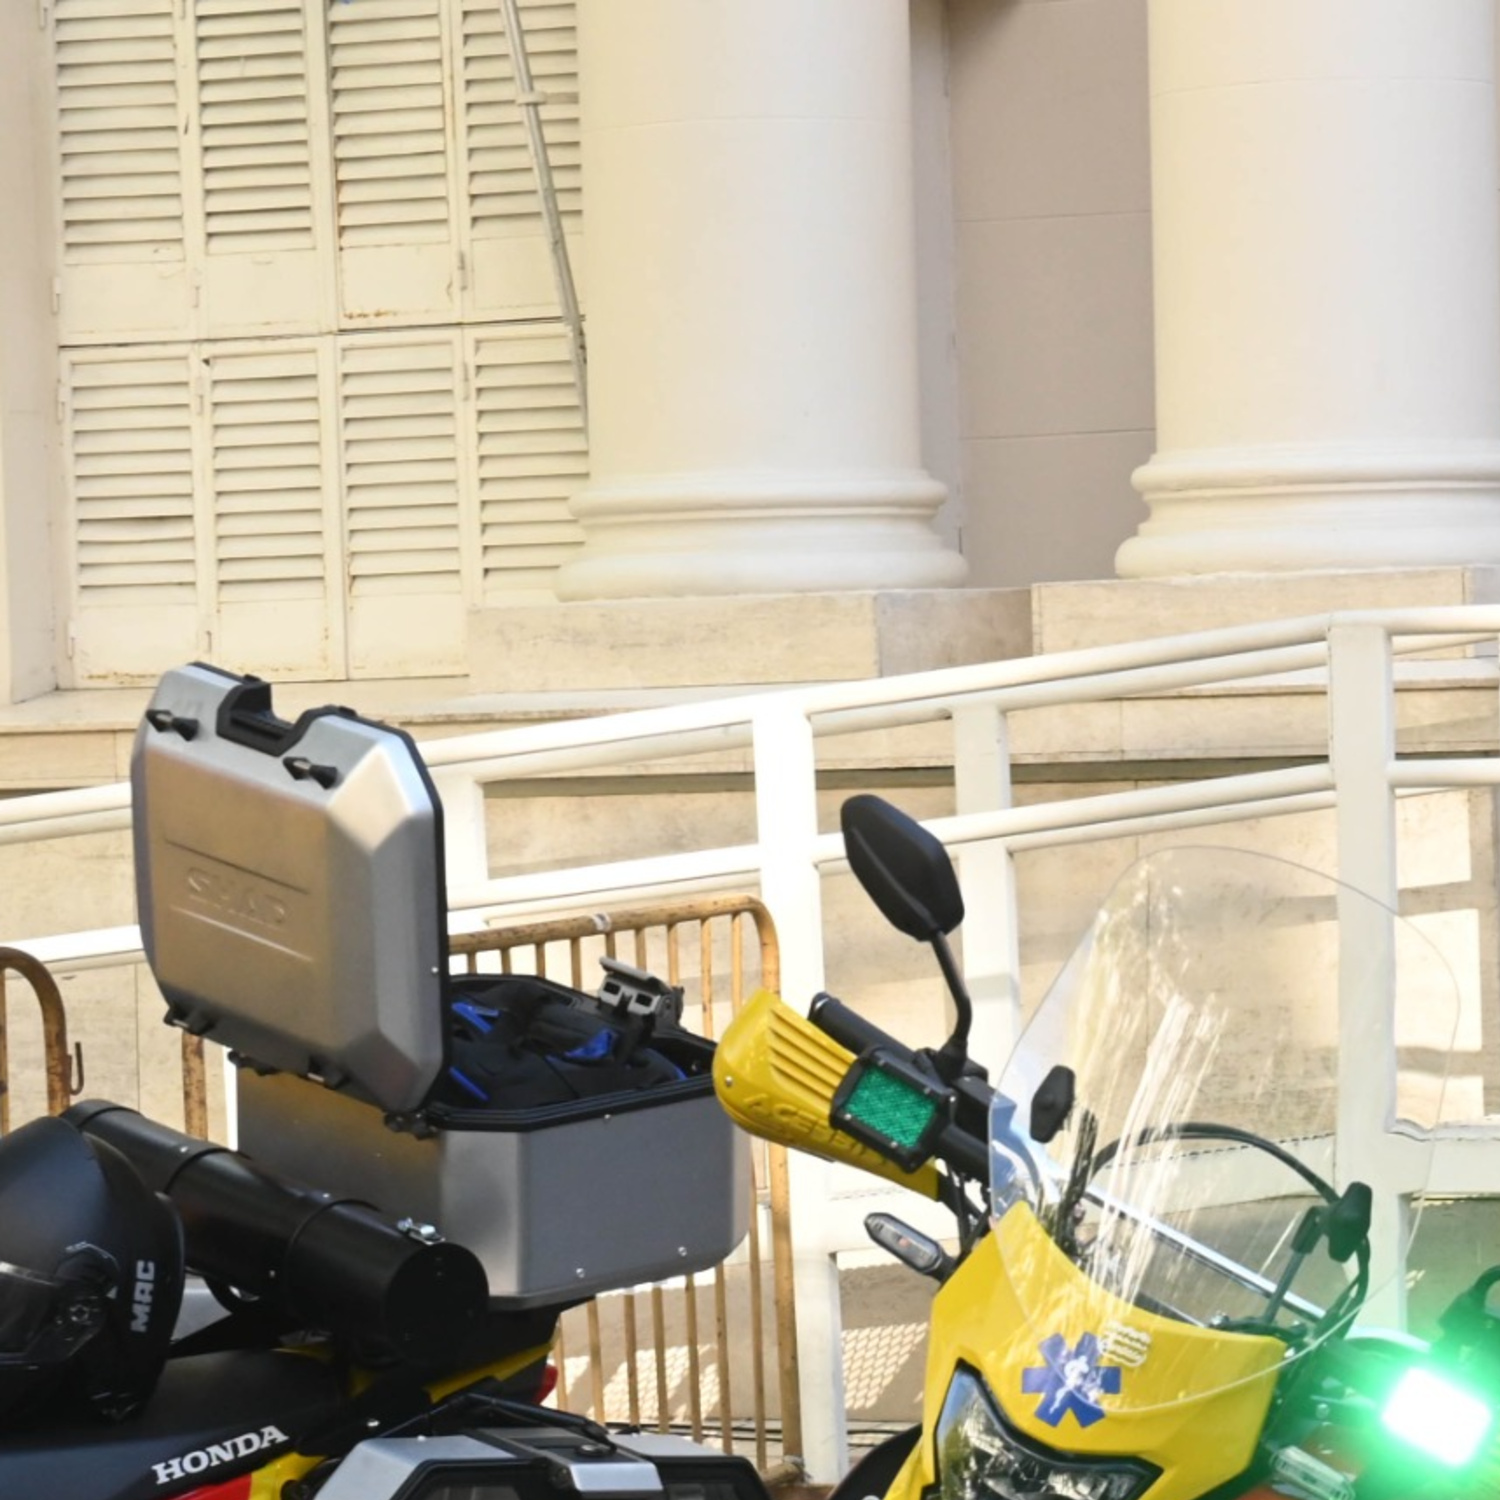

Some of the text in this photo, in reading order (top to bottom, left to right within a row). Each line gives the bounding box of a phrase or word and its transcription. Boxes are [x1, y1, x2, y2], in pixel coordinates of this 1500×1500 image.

[186, 866, 290, 933] SHAD
[130, 1260, 155, 1333] MAC
[152, 1425, 289, 1484] HONDA
